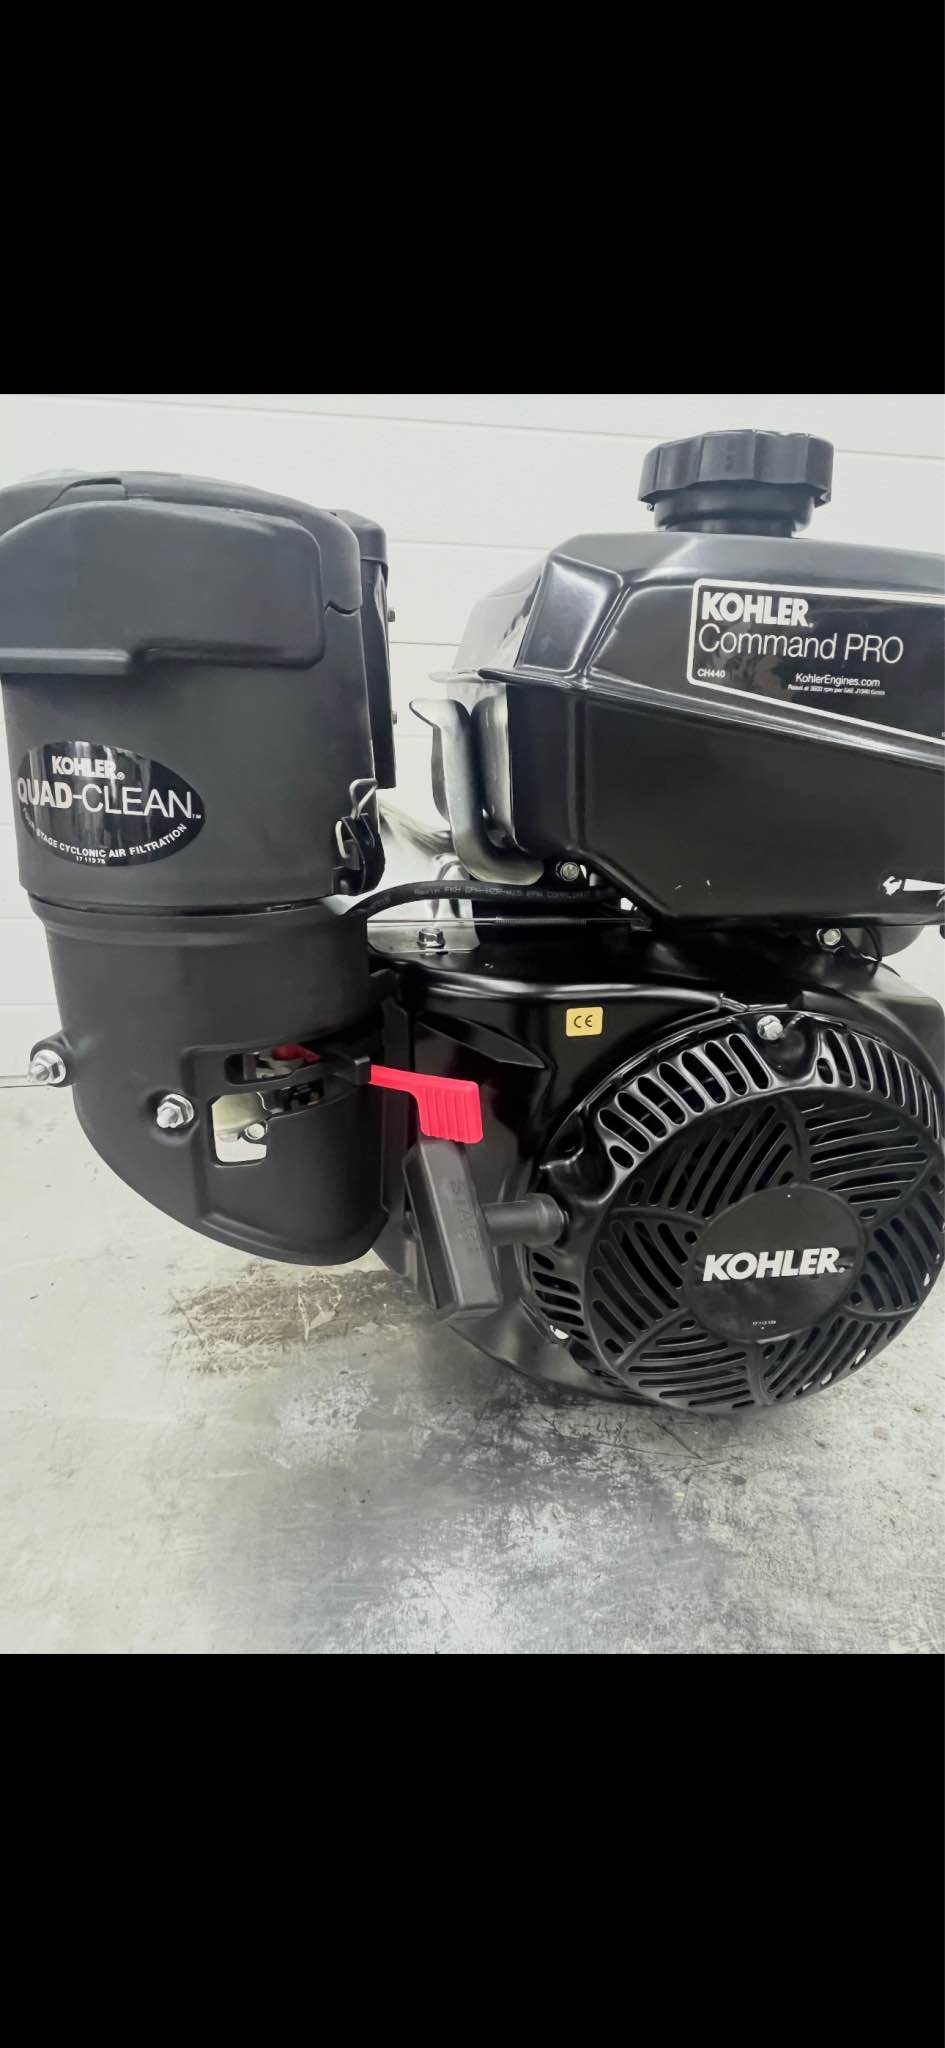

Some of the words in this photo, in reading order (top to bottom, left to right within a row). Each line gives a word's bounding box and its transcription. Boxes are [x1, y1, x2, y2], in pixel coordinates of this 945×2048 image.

[698, 623, 838, 660] Command
[844, 633, 904, 664] PRO
[697, 668, 726, 678] CH440
[795, 672, 881, 687] KohlerEngines.com
[35, 828, 58, 848] STAGE
[59, 843, 107, 858] CYCLONIC
[108, 848, 126, 858] AIR
[129, 823, 187, 856] FILTRATION
